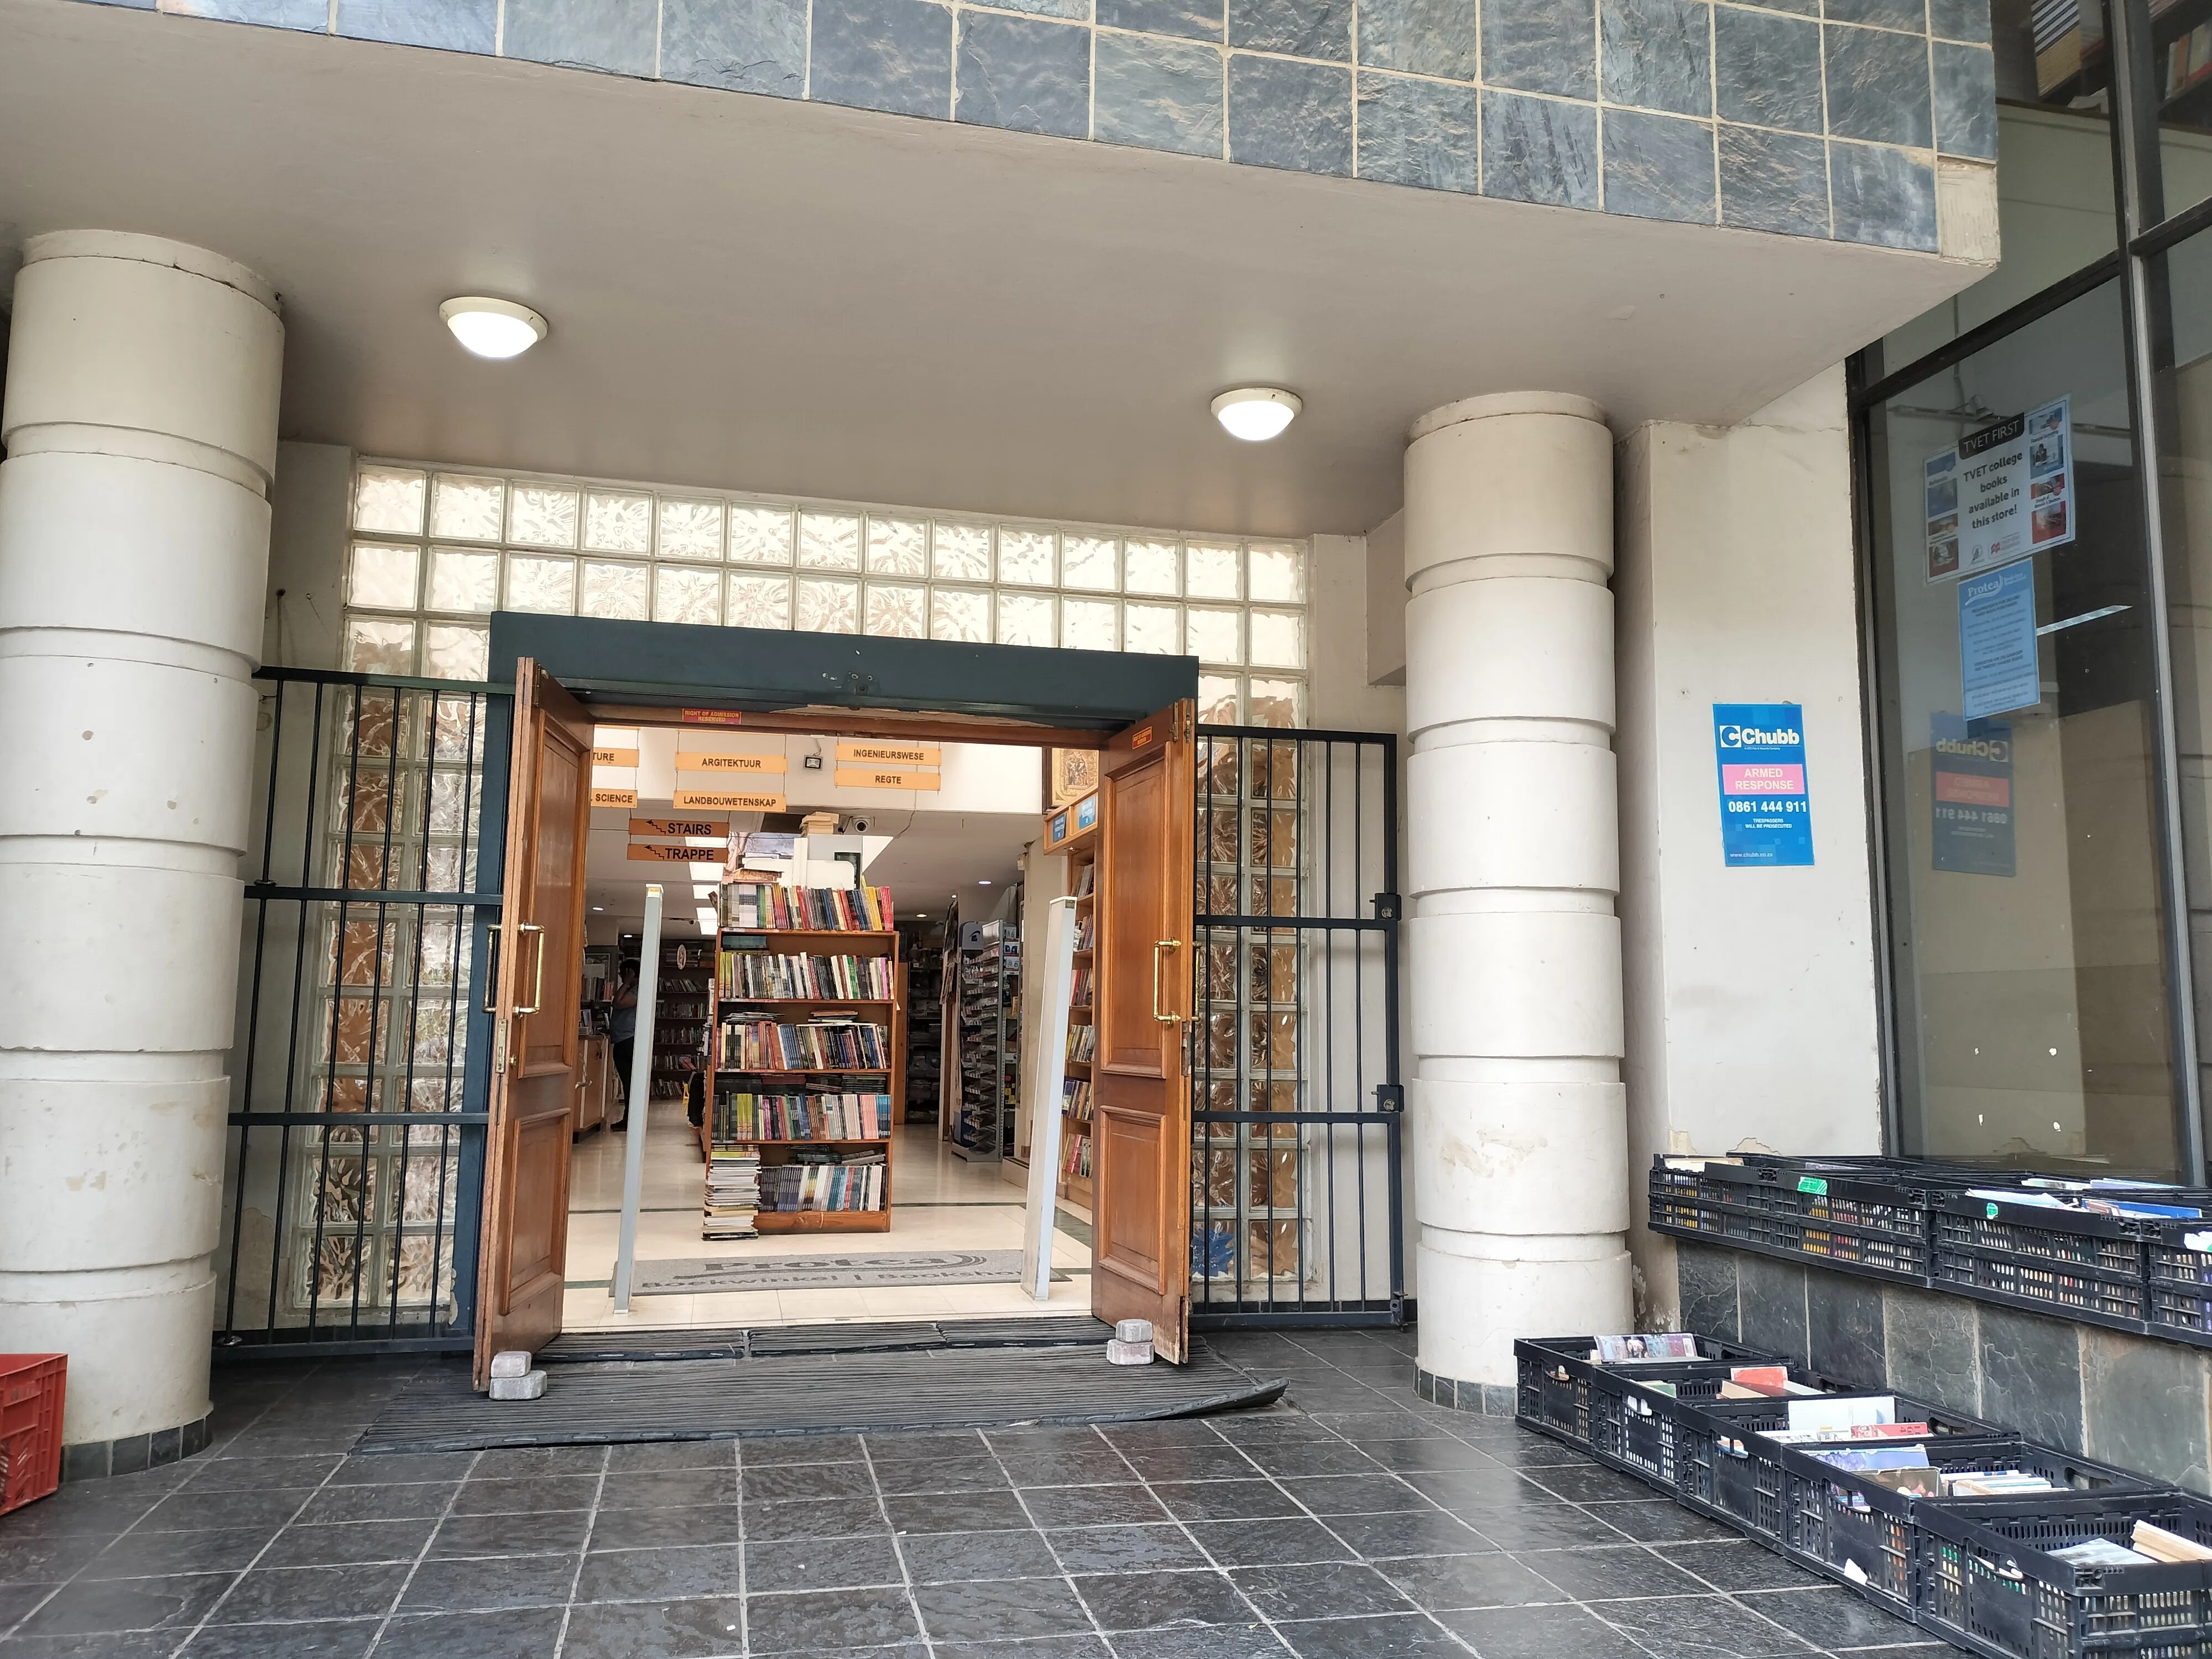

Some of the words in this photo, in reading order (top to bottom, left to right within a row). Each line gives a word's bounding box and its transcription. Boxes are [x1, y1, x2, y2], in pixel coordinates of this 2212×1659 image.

[1964, 432, 1990, 452] TVET
[1992, 420, 2019, 441] FIRST
[1963, 465, 1987, 482] TVET
[1989, 452, 2023, 472] college
[1980, 476, 2007, 493] books
[1968, 491, 2009, 514] available
[2011, 488, 2020, 498] in
[1971, 516, 1990, 529] this
[1991, 504, 2018, 523] store!
[1968, 580, 1999, 597] Protea
[1741, 728, 1800, 744] Chubb
[853, 749, 924, 760] INGENIEURSWESE
[701, 758, 761, 768] ARGITEKTUUR
[1744, 768, 1783, 778] ARMED
[875, 775, 902, 784] REGTE
[1735, 780, 1794, 790] RESPONSE
[595, 793, 633, 803] SCIENCE
[684, 796, 776, 807] LANDBOUWETENSKAP
[1728, 801, 1757, 812] 0861
[1761, 801, 1783, 812] 444
[1786, 801, 1807, 812] 911
[667, 822, 712, 835] STAIRS
[665, 848, 714, 860] TRAPPE
[705, 1258, 947, 1271] Protea
